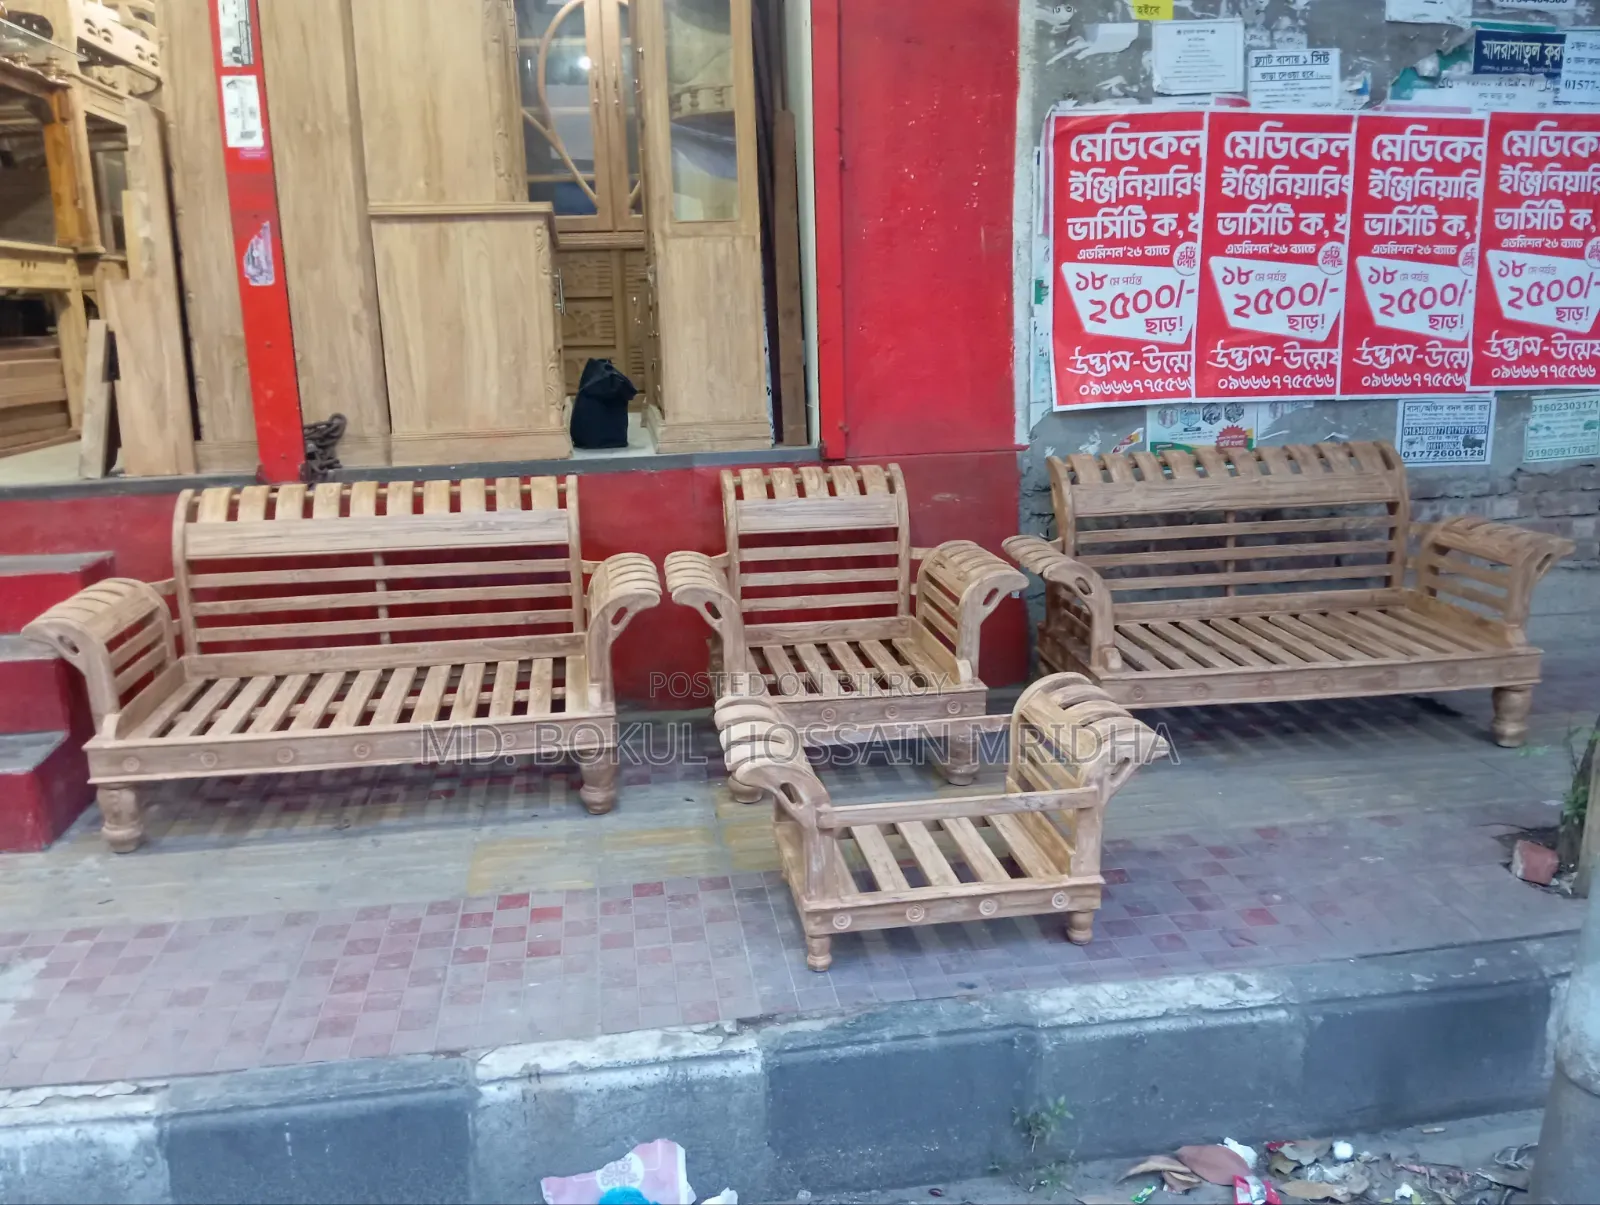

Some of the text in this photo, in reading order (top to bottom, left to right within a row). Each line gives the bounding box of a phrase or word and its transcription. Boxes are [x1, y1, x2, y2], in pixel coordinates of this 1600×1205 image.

[1565, 80, 1600, 90] 01577-
[1224, 120, 1352, 160] মেডিকেল
[1502, 120, 1600, 158] মেডিকে
[1368, 167, 1482, 202] ইঞ্জিনিয়ারি
[1067, 205, 1147, 240] ভার্সিটি
[1217, 203, 1295, 236] ভার্সিটি
[1364, 204, 1439, 237] ভার্সিটি
[1494, 199, 1566, 230] ভার্সিটি
[1144, 245, 1171, 256] ব্যাচে
[1290, 243, 1316, 254] ব্যাচে
[1075, 271, 1143, 291] ১৮ মে পর্যন্ত
[1222, 266, 1254, 285] ১৮
[1368, 265, 1398, 285] ১৮
[1498, 260, 1527, 277] ১৮
[1233, 278, 1339, 319] ২৫০০/-
[1066, 345, 1192, 377] উদ্ভাস-উন্মে
[1352, 337, 1470, 369] উদ্ভাস-উন্মে
[1403, 450, 1484, 459] 01772600128
